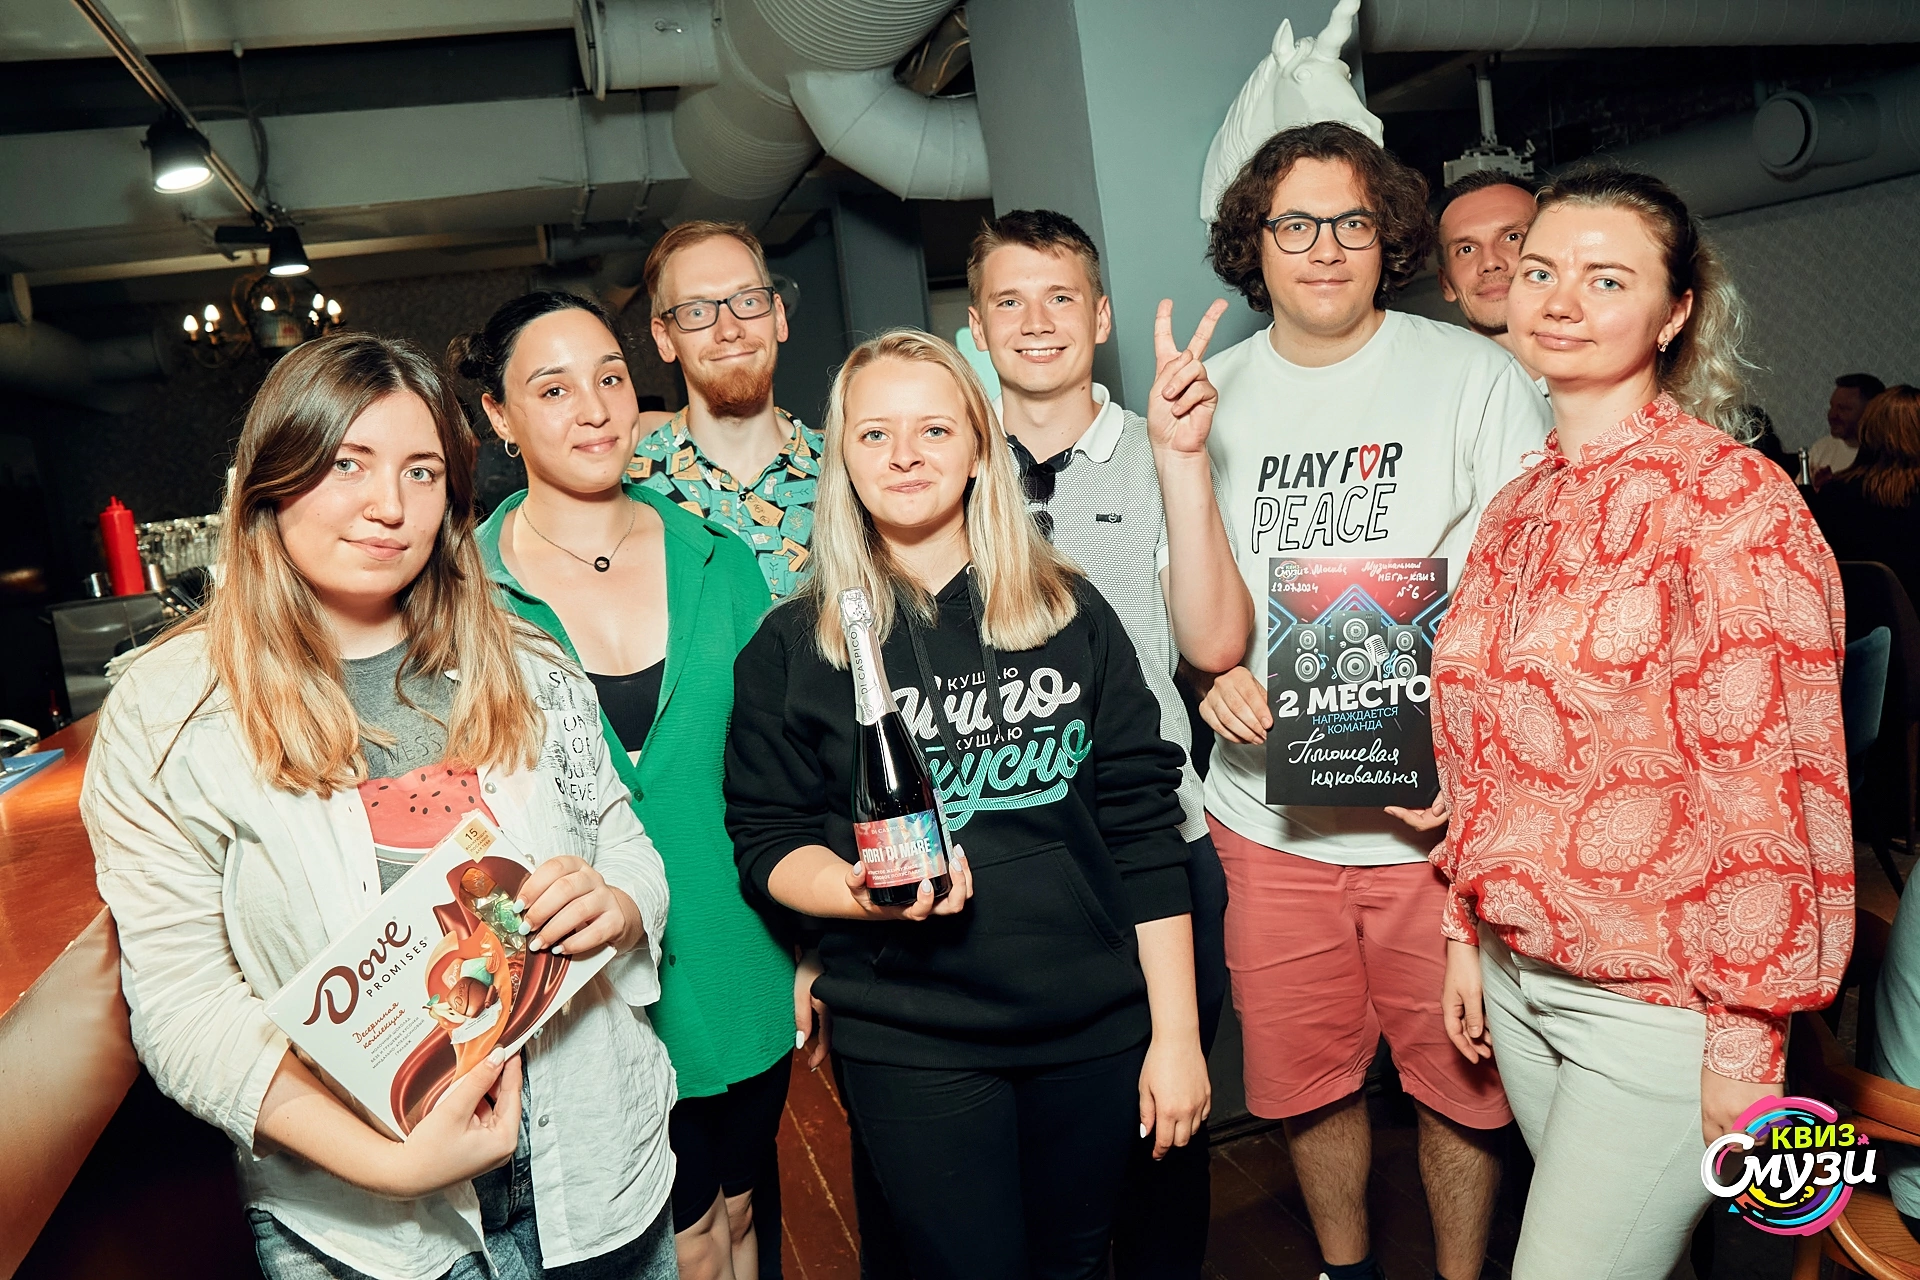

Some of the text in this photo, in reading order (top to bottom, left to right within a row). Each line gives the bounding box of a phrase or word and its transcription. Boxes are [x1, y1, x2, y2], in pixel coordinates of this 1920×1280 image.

[1258, 450, 1339, 492] PLAY
[1251, 483, 1397, 554] PEACE
[947, 667, 1019, 691] КУШЮ
[1278, 675, 1431, 718] 2 МЕСТО
[1312, 707, 1399, 725] НАГРАЖДАЕТСЯ
[1327, 720, 1383, 734] КОМАНДА
[465, 828, 478, 840] 15
[886, 844, 898, 860] DI
[898, 838, 932, 858] MARE
[302, 921, 411, 1026] Dove
[366, 939, 428, 997] PROMISES
[352, 1002, 399, 1043] Десертная
[363, 1009, 406, 1049] коллекция
